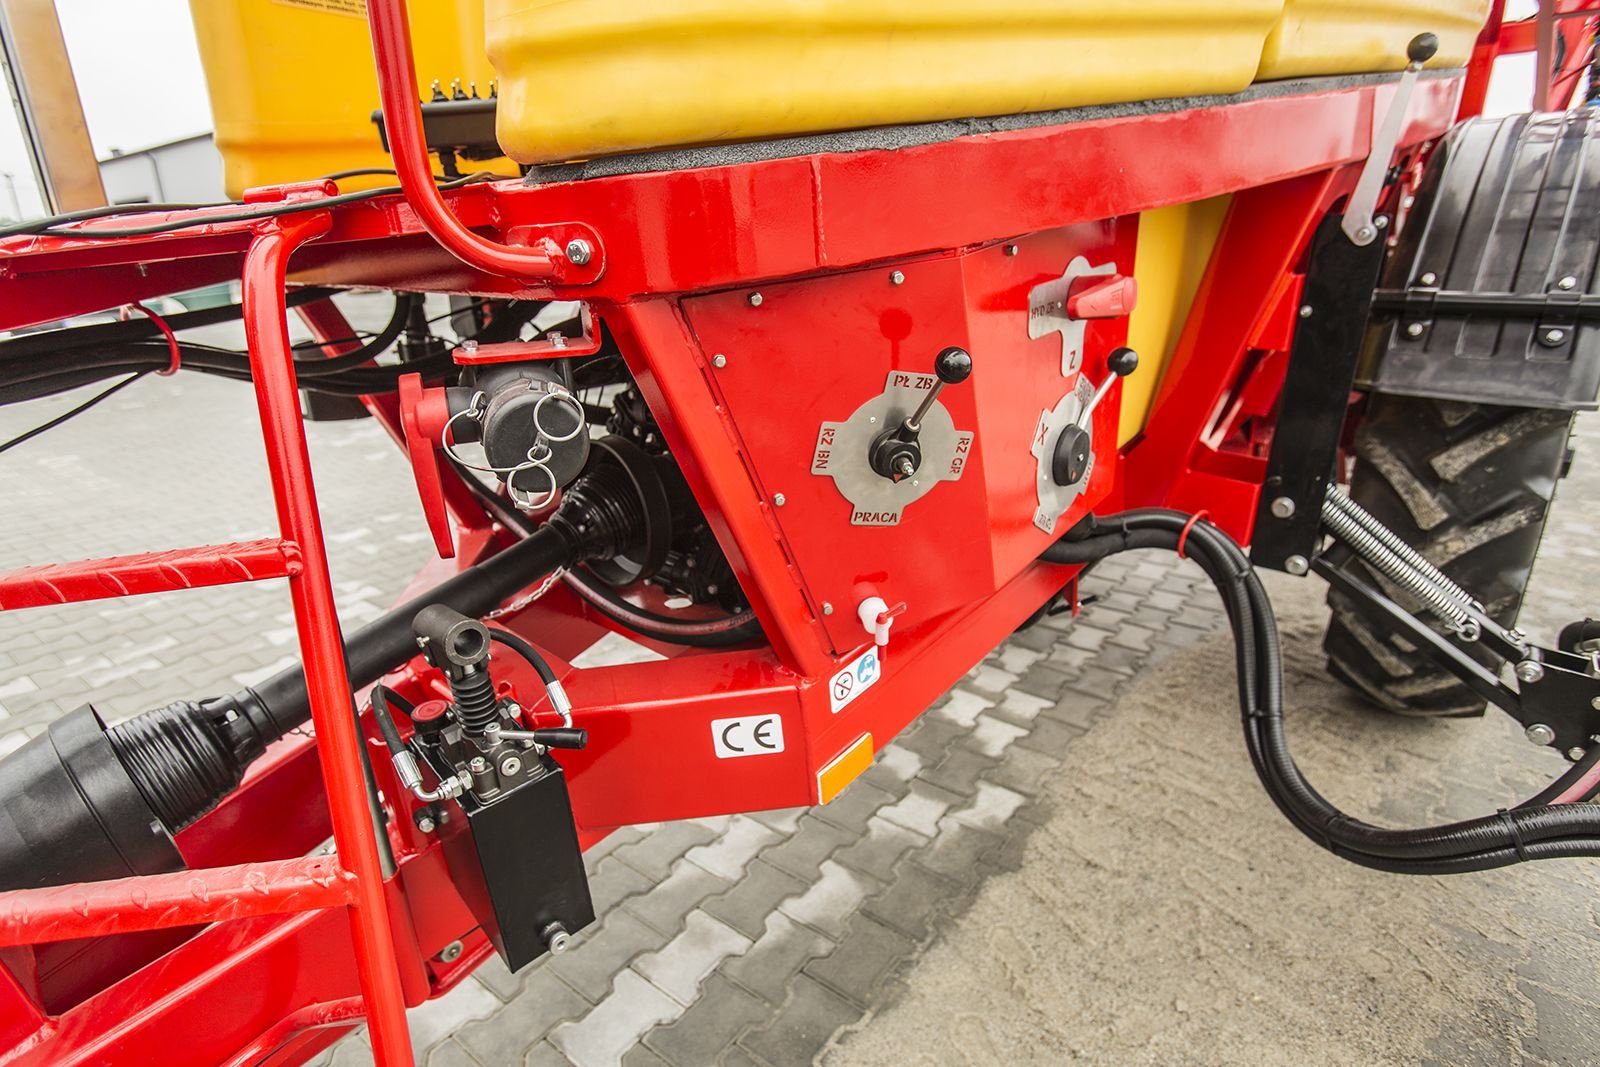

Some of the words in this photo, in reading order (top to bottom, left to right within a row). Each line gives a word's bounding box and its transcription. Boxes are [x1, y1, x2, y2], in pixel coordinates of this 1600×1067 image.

[914, 376, 934, 390] ZB
[820, 428, 836, 446] RZ
[1037, 423, 1049, 446] X
[955, 437, 971, 454] RZ
[949, 457, 964, 474] GR
[853, 511, 898, 523] PRACA
[722, 719, 776, 752] CE
